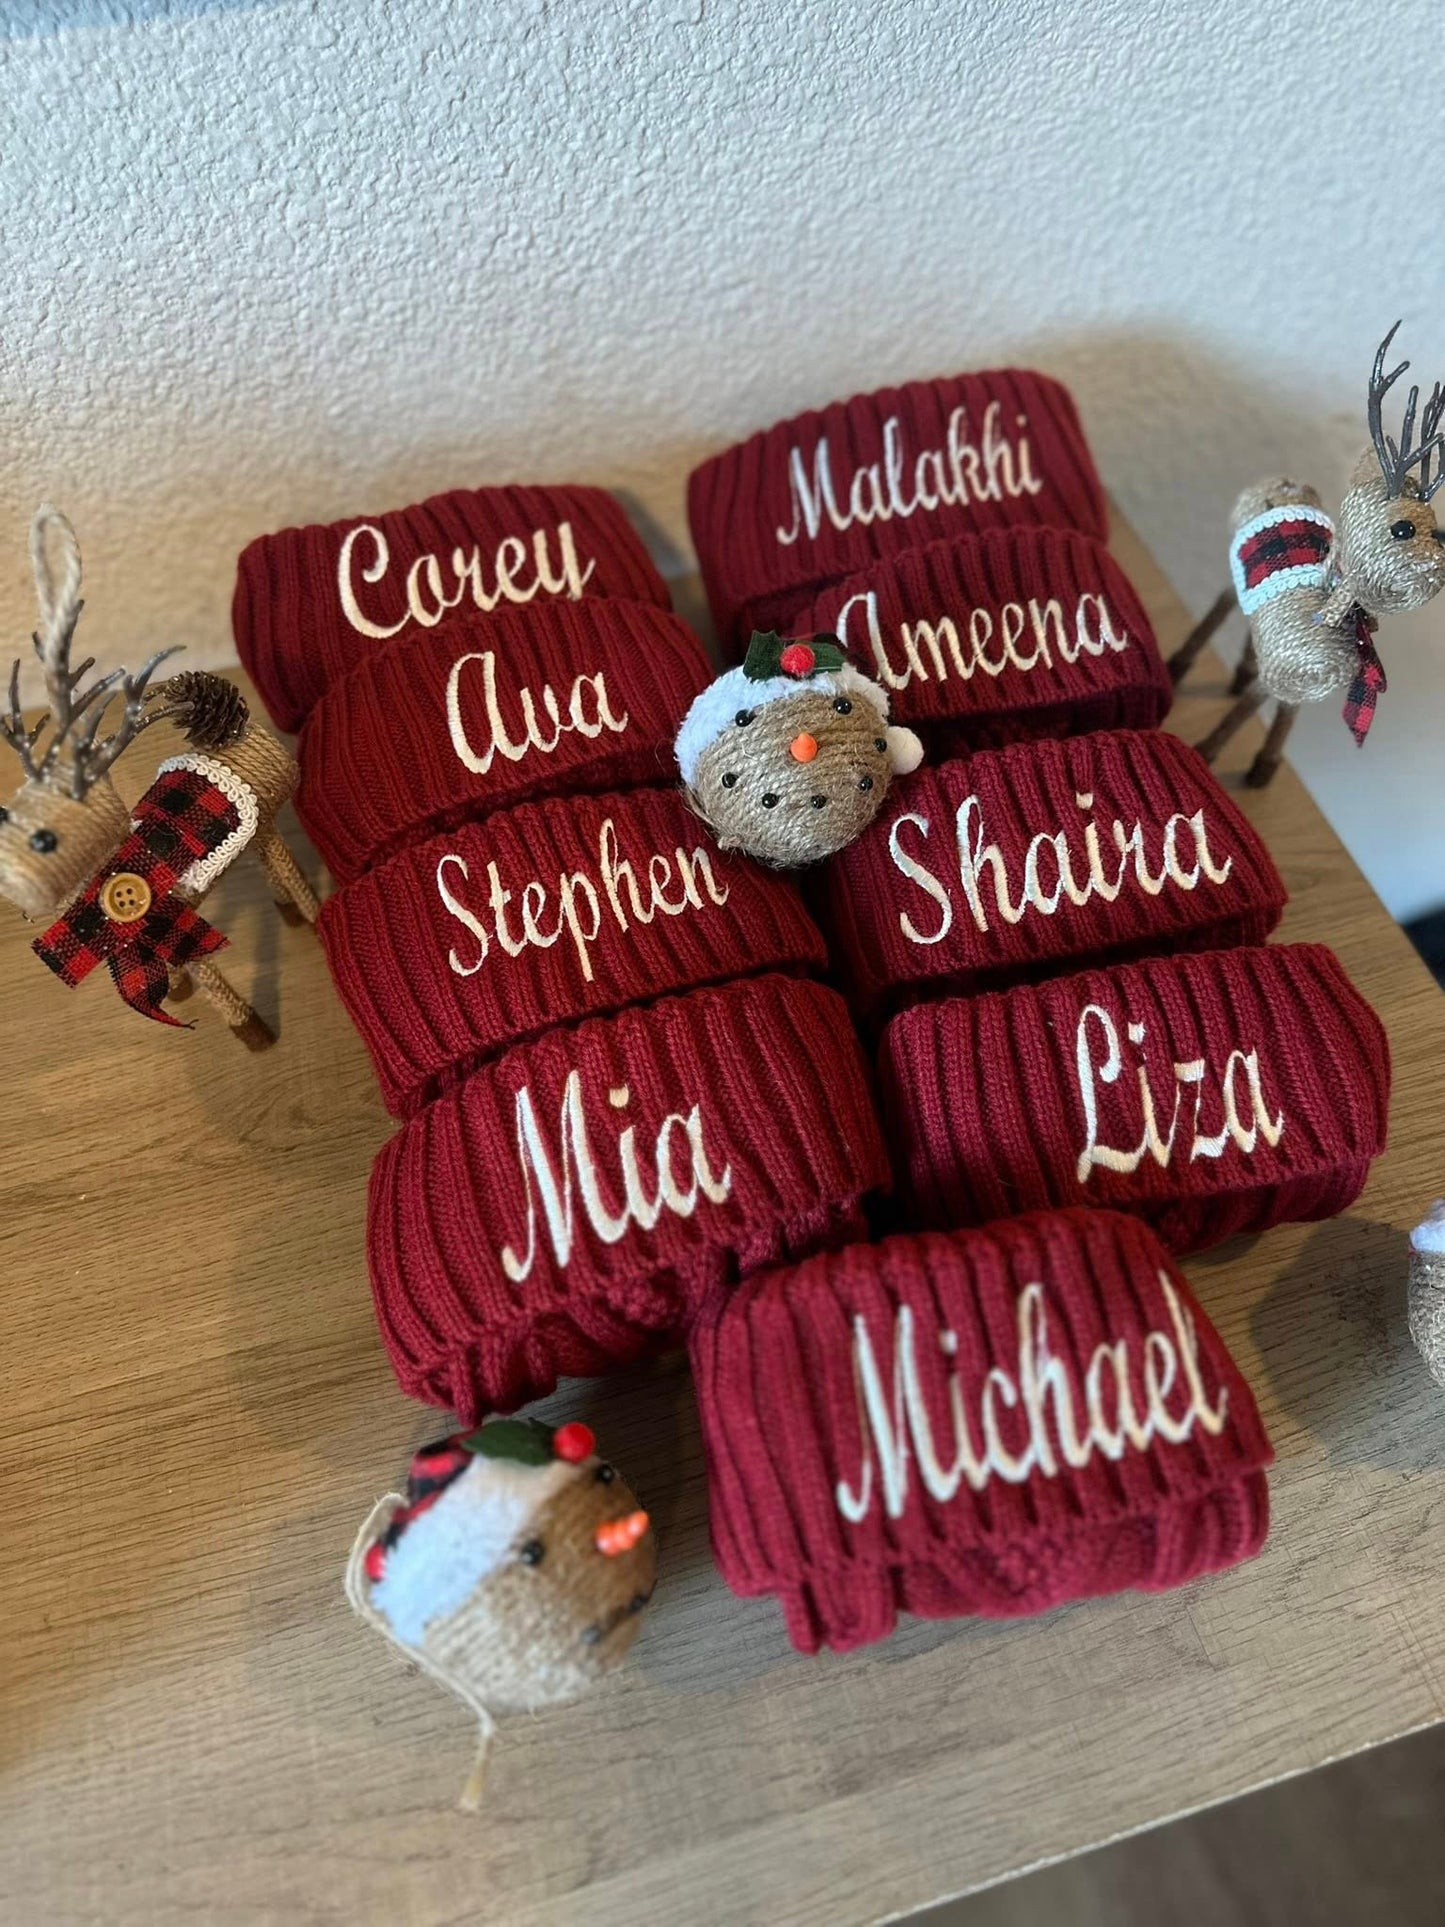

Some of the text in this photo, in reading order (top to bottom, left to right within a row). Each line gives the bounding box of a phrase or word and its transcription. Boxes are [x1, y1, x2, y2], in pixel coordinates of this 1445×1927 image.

[776, 401, 1043, 545] Malakhi
[337, 522, 596, 639] Corey
[836, 591, 1128, 690] Ameena
[446, 651, 629, 774] Ava
[436, 818, 731, 983] Stephen
[889, 793, 1233, 945] Shaira
[1075, 1003, 1287, 1183] Liza
[502, 1070, 733, 1283] Mia
[836, 1271, 1229, 1523] Michael
